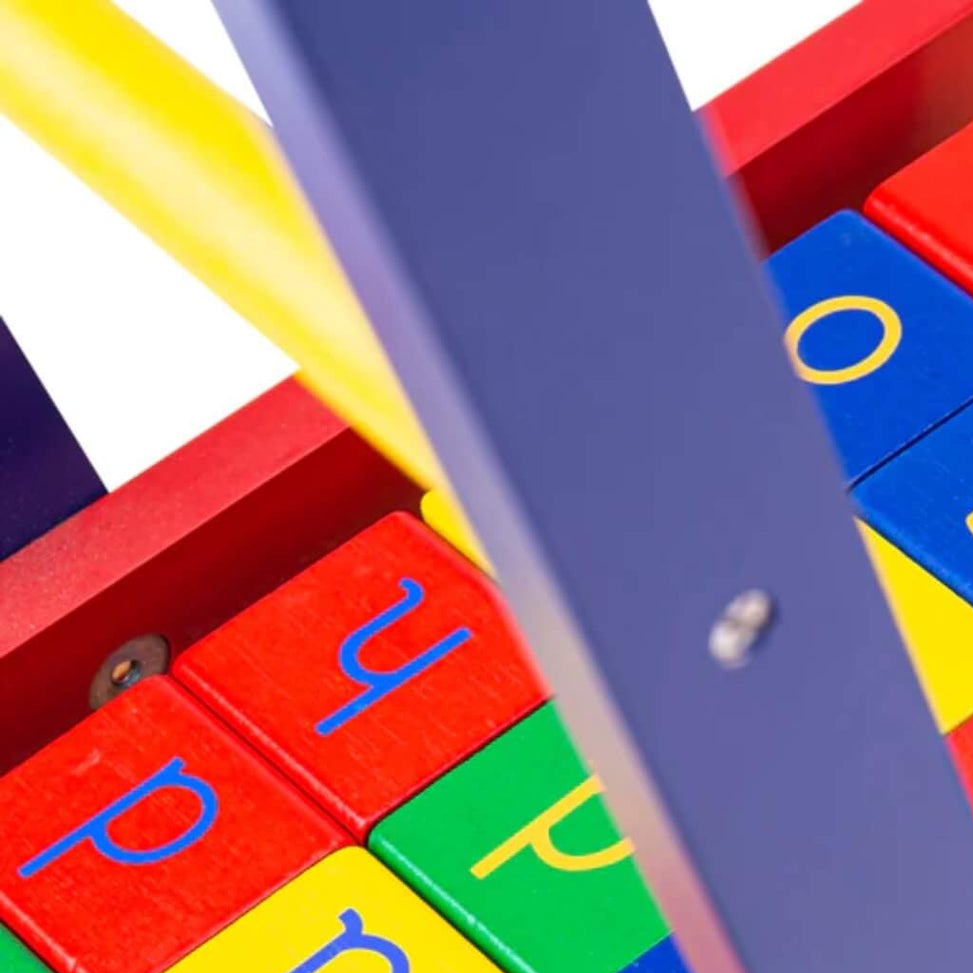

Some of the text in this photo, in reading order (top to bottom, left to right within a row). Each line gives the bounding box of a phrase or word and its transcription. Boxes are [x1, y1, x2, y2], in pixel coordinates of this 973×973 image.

[784, 295, 902, 385] o
[316, 578, 471, 736] h
[18, 756, 219, 878] d
